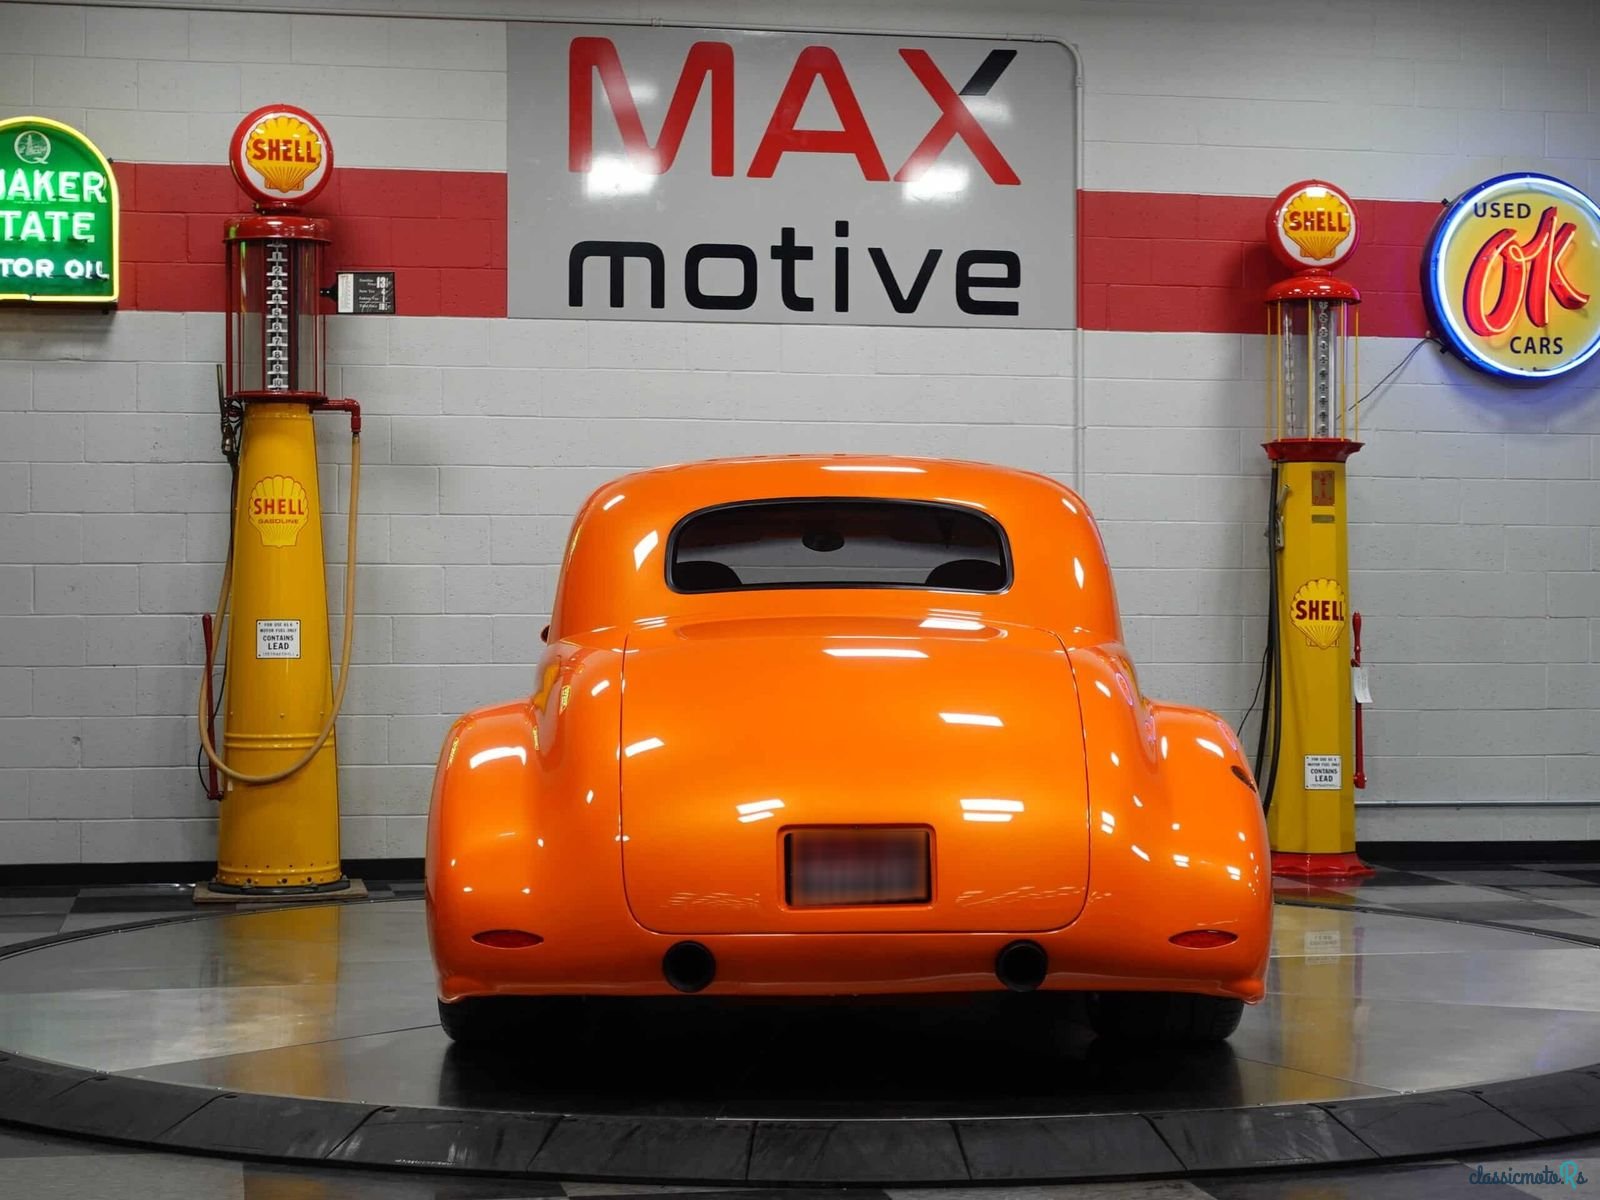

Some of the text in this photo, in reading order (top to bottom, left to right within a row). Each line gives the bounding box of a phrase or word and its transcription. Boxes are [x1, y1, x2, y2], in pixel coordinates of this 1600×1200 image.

[568, 36, 1021, 185] MAX
[252, 138, 317, 163] SHELL
[1474, 202, 1531, 218] USED
[1289, 211, 1347, 232] SHELL
[64, 259, 110, 280] OIL
[568, 219, 1021, 316] motive
[1463, 206, 1591, 336] OK
[1509, 336, 1564, 354] CARS
[254, 498, 305, 515] SHELL
[1295, 600, 1345, 622] SHELL
[267, 642, 290, 650] LEAD
